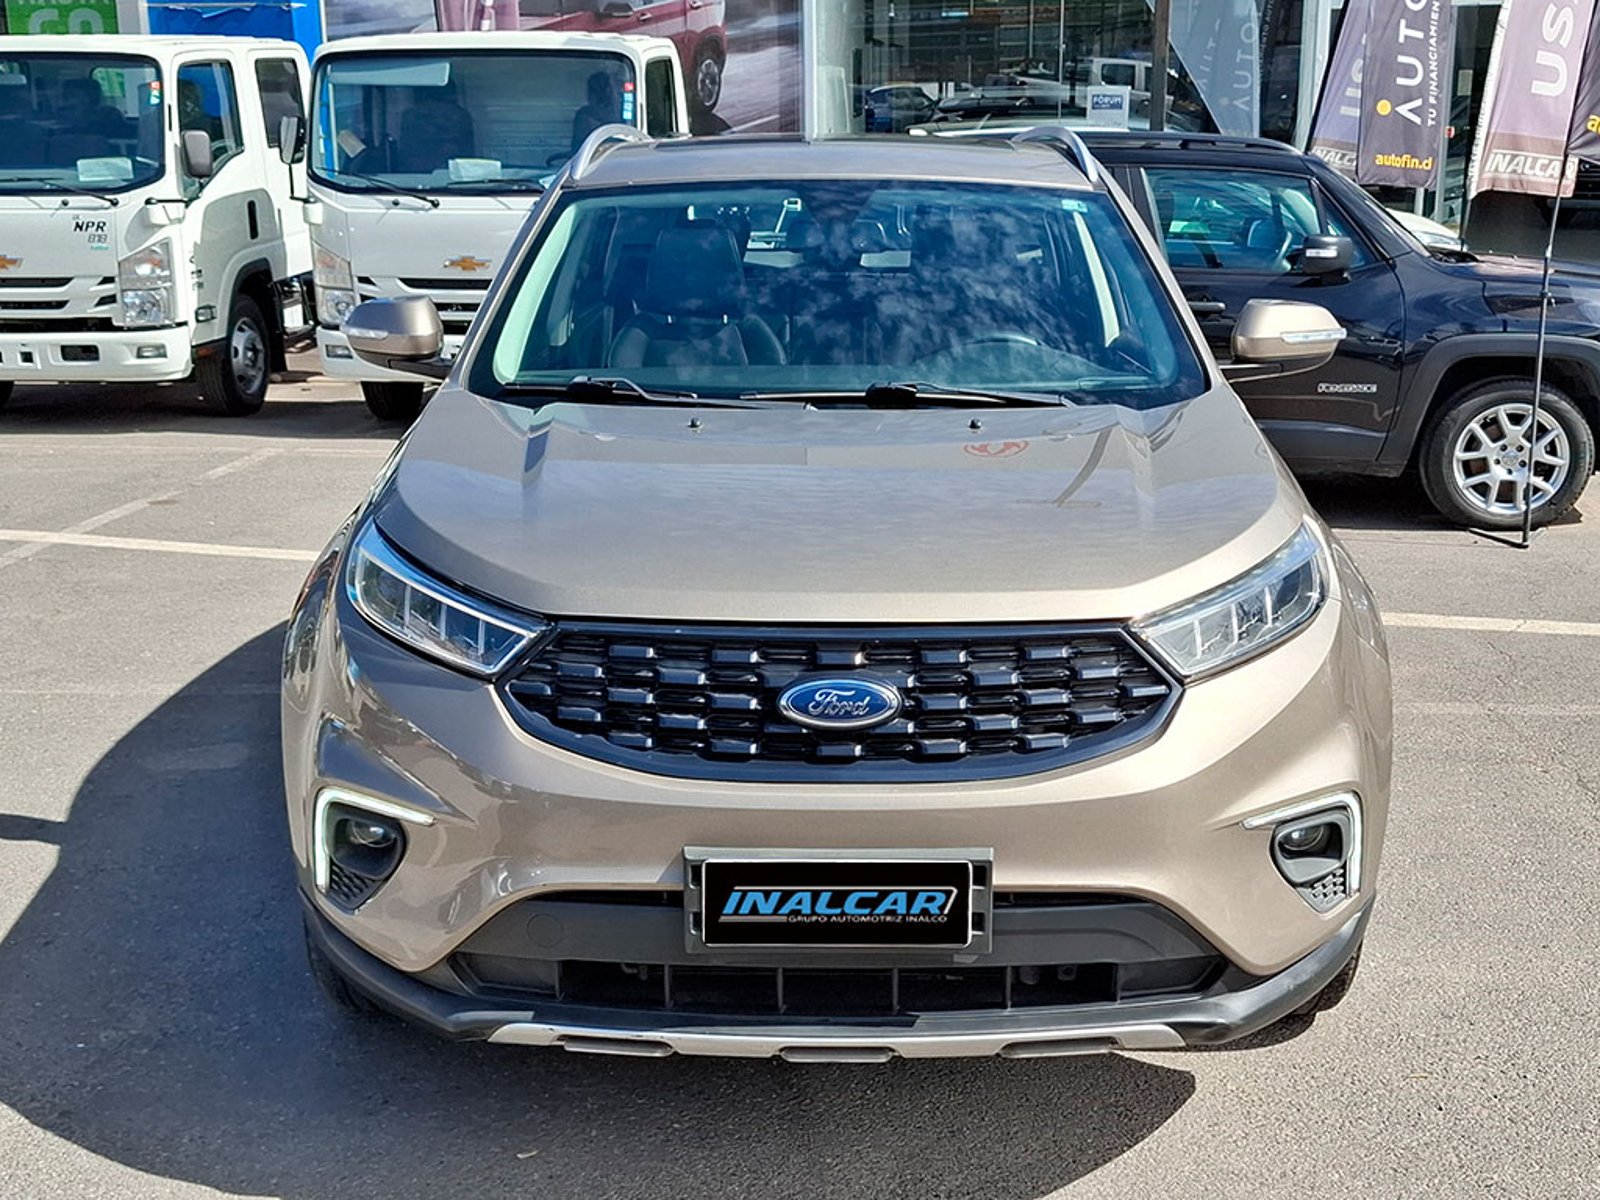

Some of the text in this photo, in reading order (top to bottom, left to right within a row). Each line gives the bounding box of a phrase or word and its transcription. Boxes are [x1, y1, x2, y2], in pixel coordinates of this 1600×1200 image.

[1531, 0, 1580, 97] US
[1428, 109, 1438, 127] TU
[73, 221, 107, 232] NPR
[808, 688, 871, 716] Ford
[722, 891, 948, 915] INALCAR
[788, 915, 948, 923] GRUPO AUTOMOTRIZ INALCO
